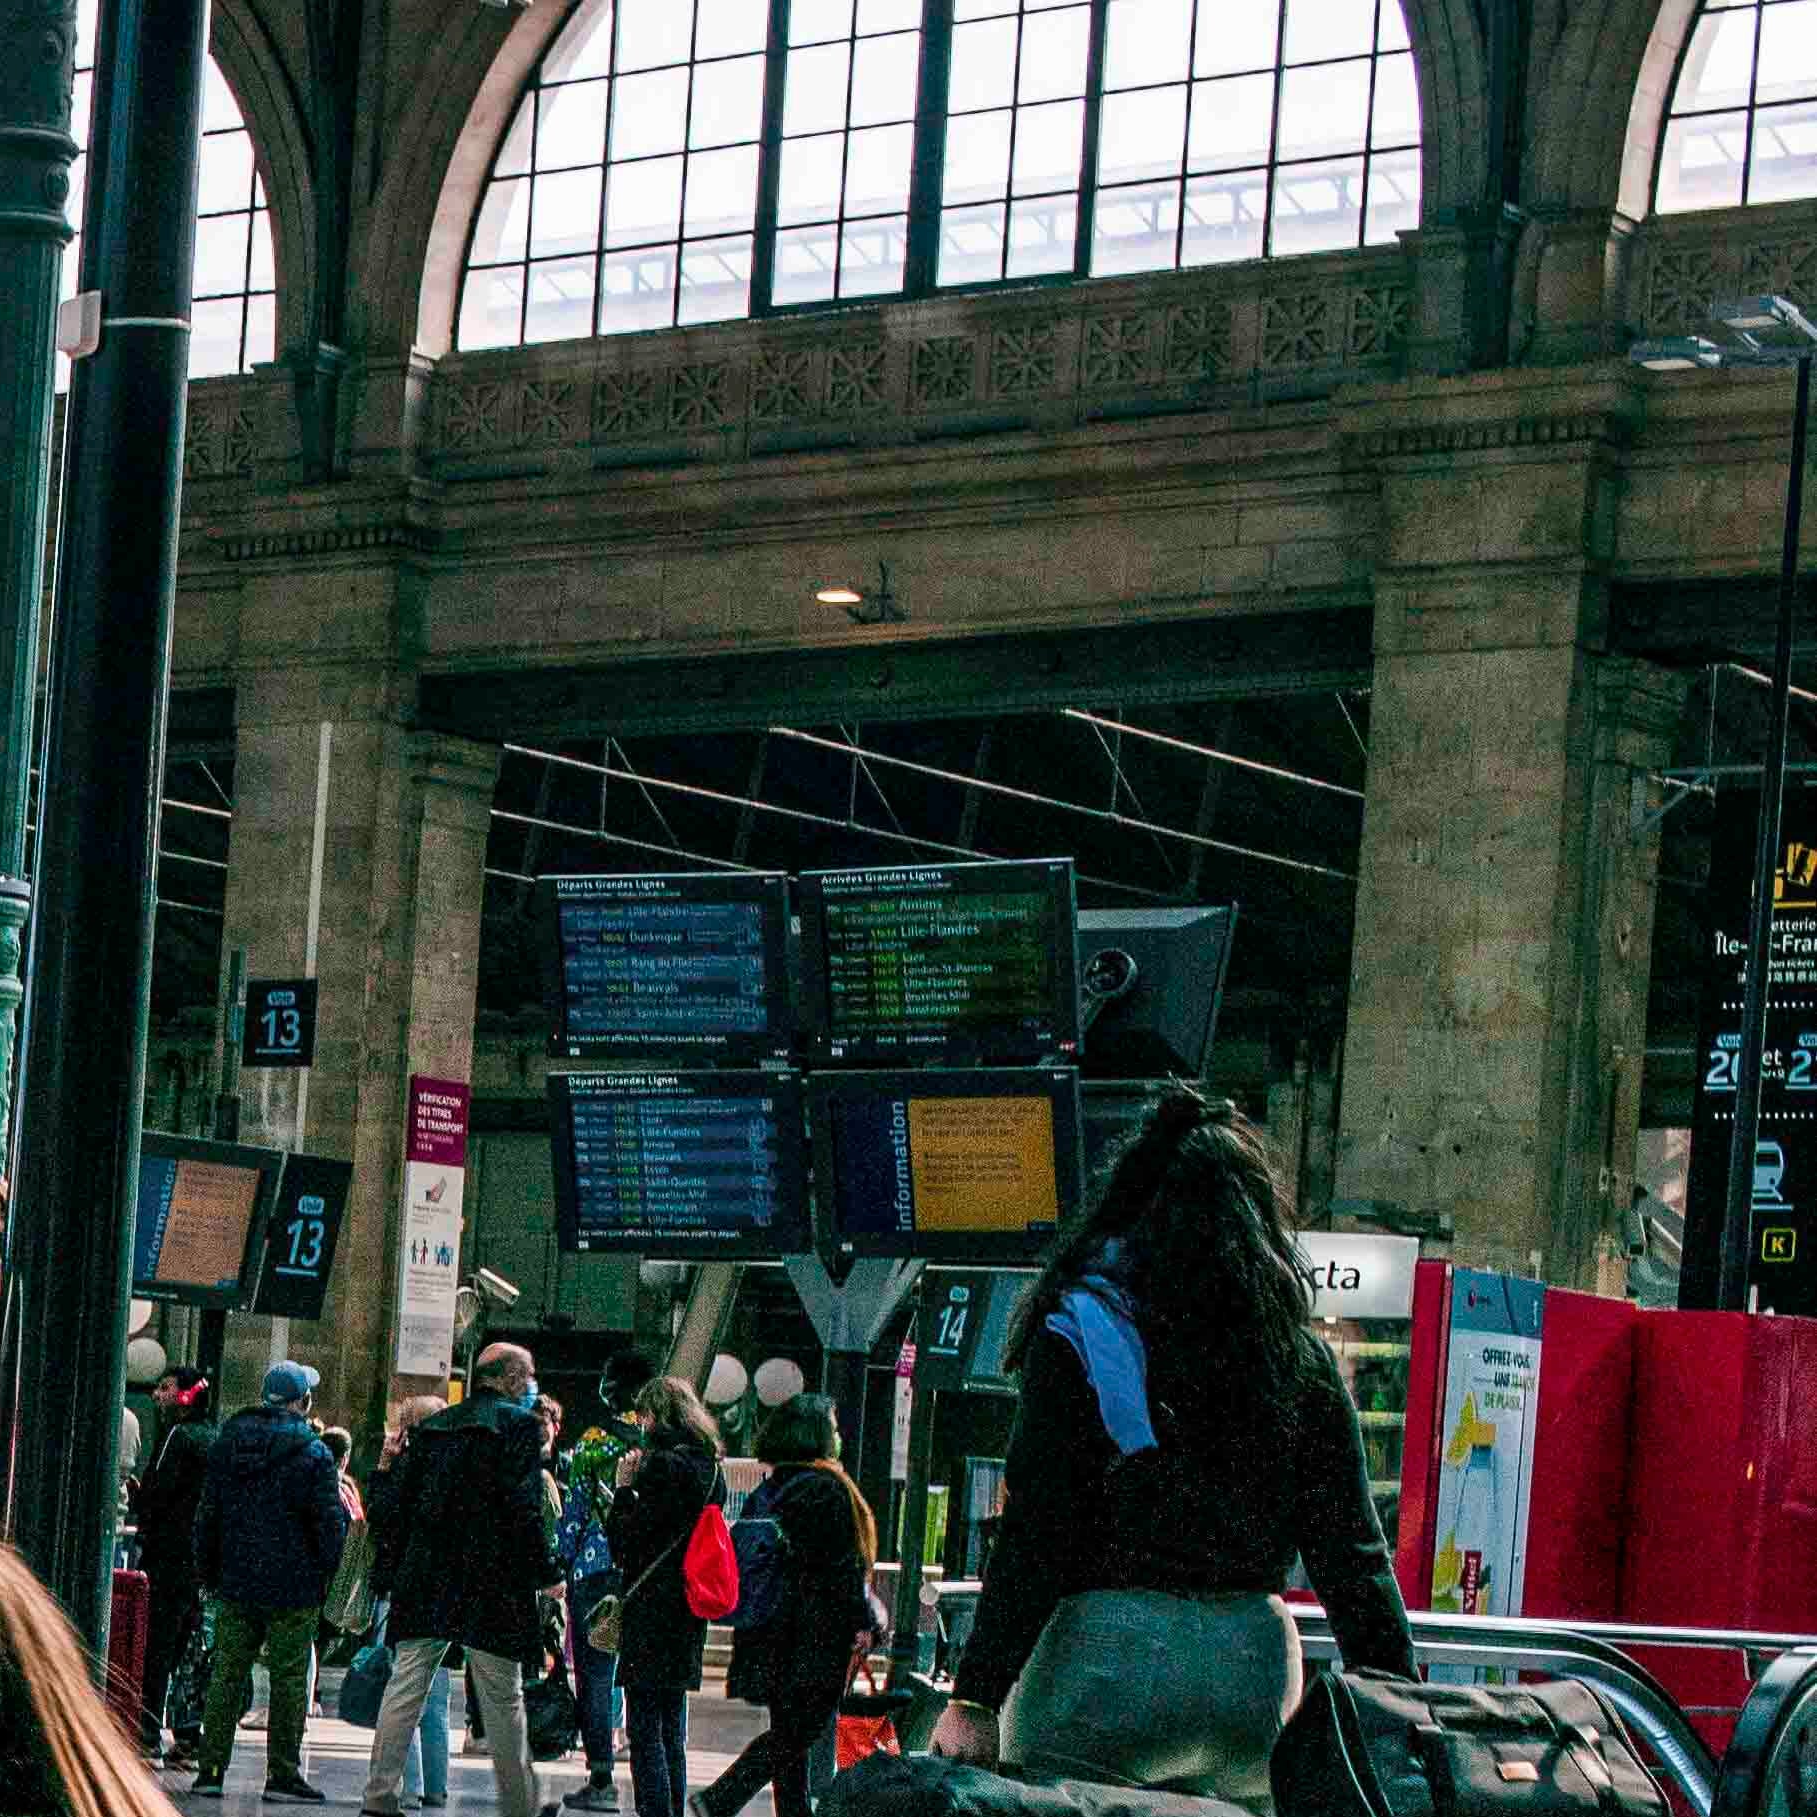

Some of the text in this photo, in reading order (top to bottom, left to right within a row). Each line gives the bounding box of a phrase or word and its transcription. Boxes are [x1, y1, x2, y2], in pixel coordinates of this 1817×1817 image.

[261, 1008, 301, 1048] 13
[889, 1101, 912, 1232] information
[287, 1217, 324, 1267] 13
[1771, 1236, 1784, 1252] K
[938, 1305, 968, 1347] 14
